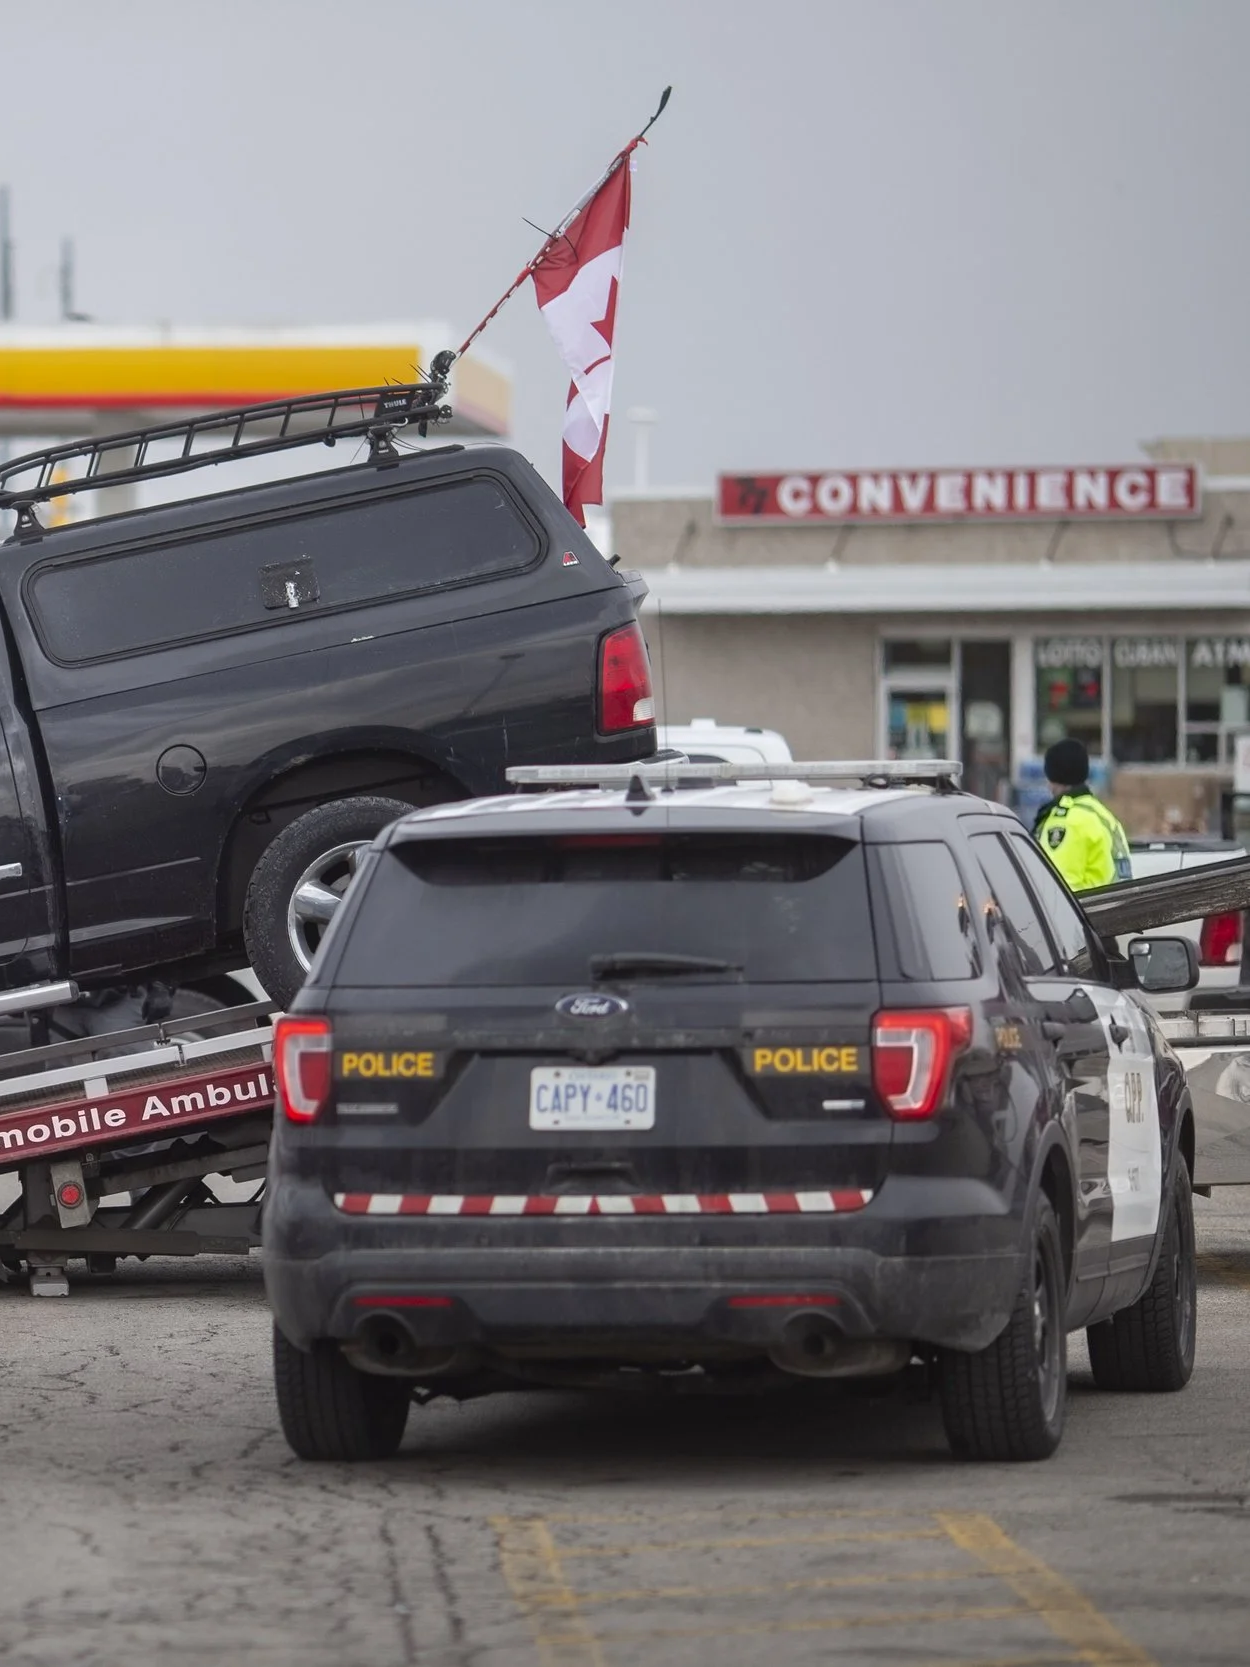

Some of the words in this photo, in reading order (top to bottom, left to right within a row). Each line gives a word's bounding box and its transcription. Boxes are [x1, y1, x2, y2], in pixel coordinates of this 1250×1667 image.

[775, 469, 1189, 518] CONVENIENCE
[570, 998, 610, 1015] Ford
[341, 1051, 435, 1078] POLICE
[754, 1047, 860, 1073] POLICE
